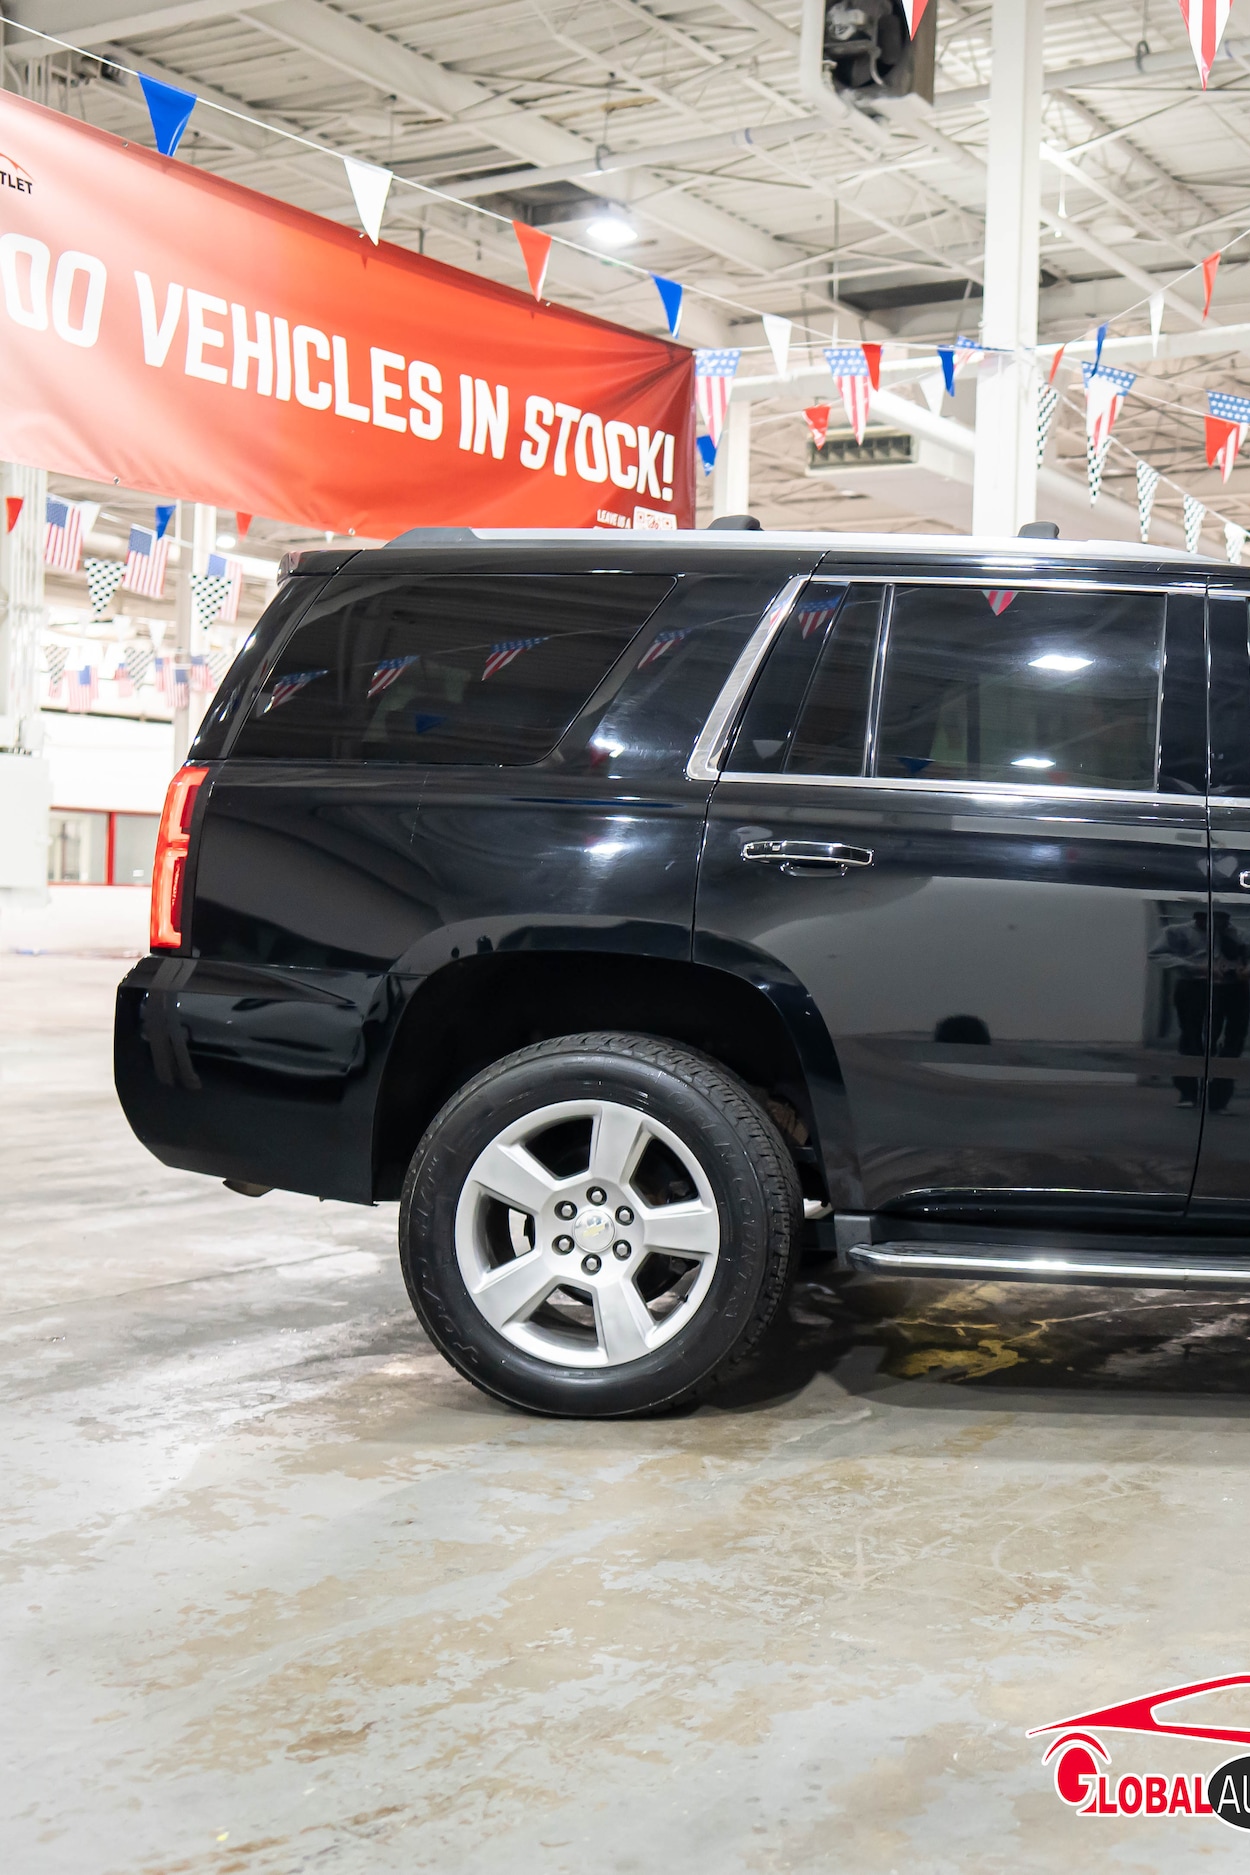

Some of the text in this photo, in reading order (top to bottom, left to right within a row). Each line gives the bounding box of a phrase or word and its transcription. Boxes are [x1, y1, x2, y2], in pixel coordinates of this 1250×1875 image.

[134, 270, 443, 441] VEHICLES
[458, 373, 509, 460] IN
[520, 394, 675, 502] STOCK!
